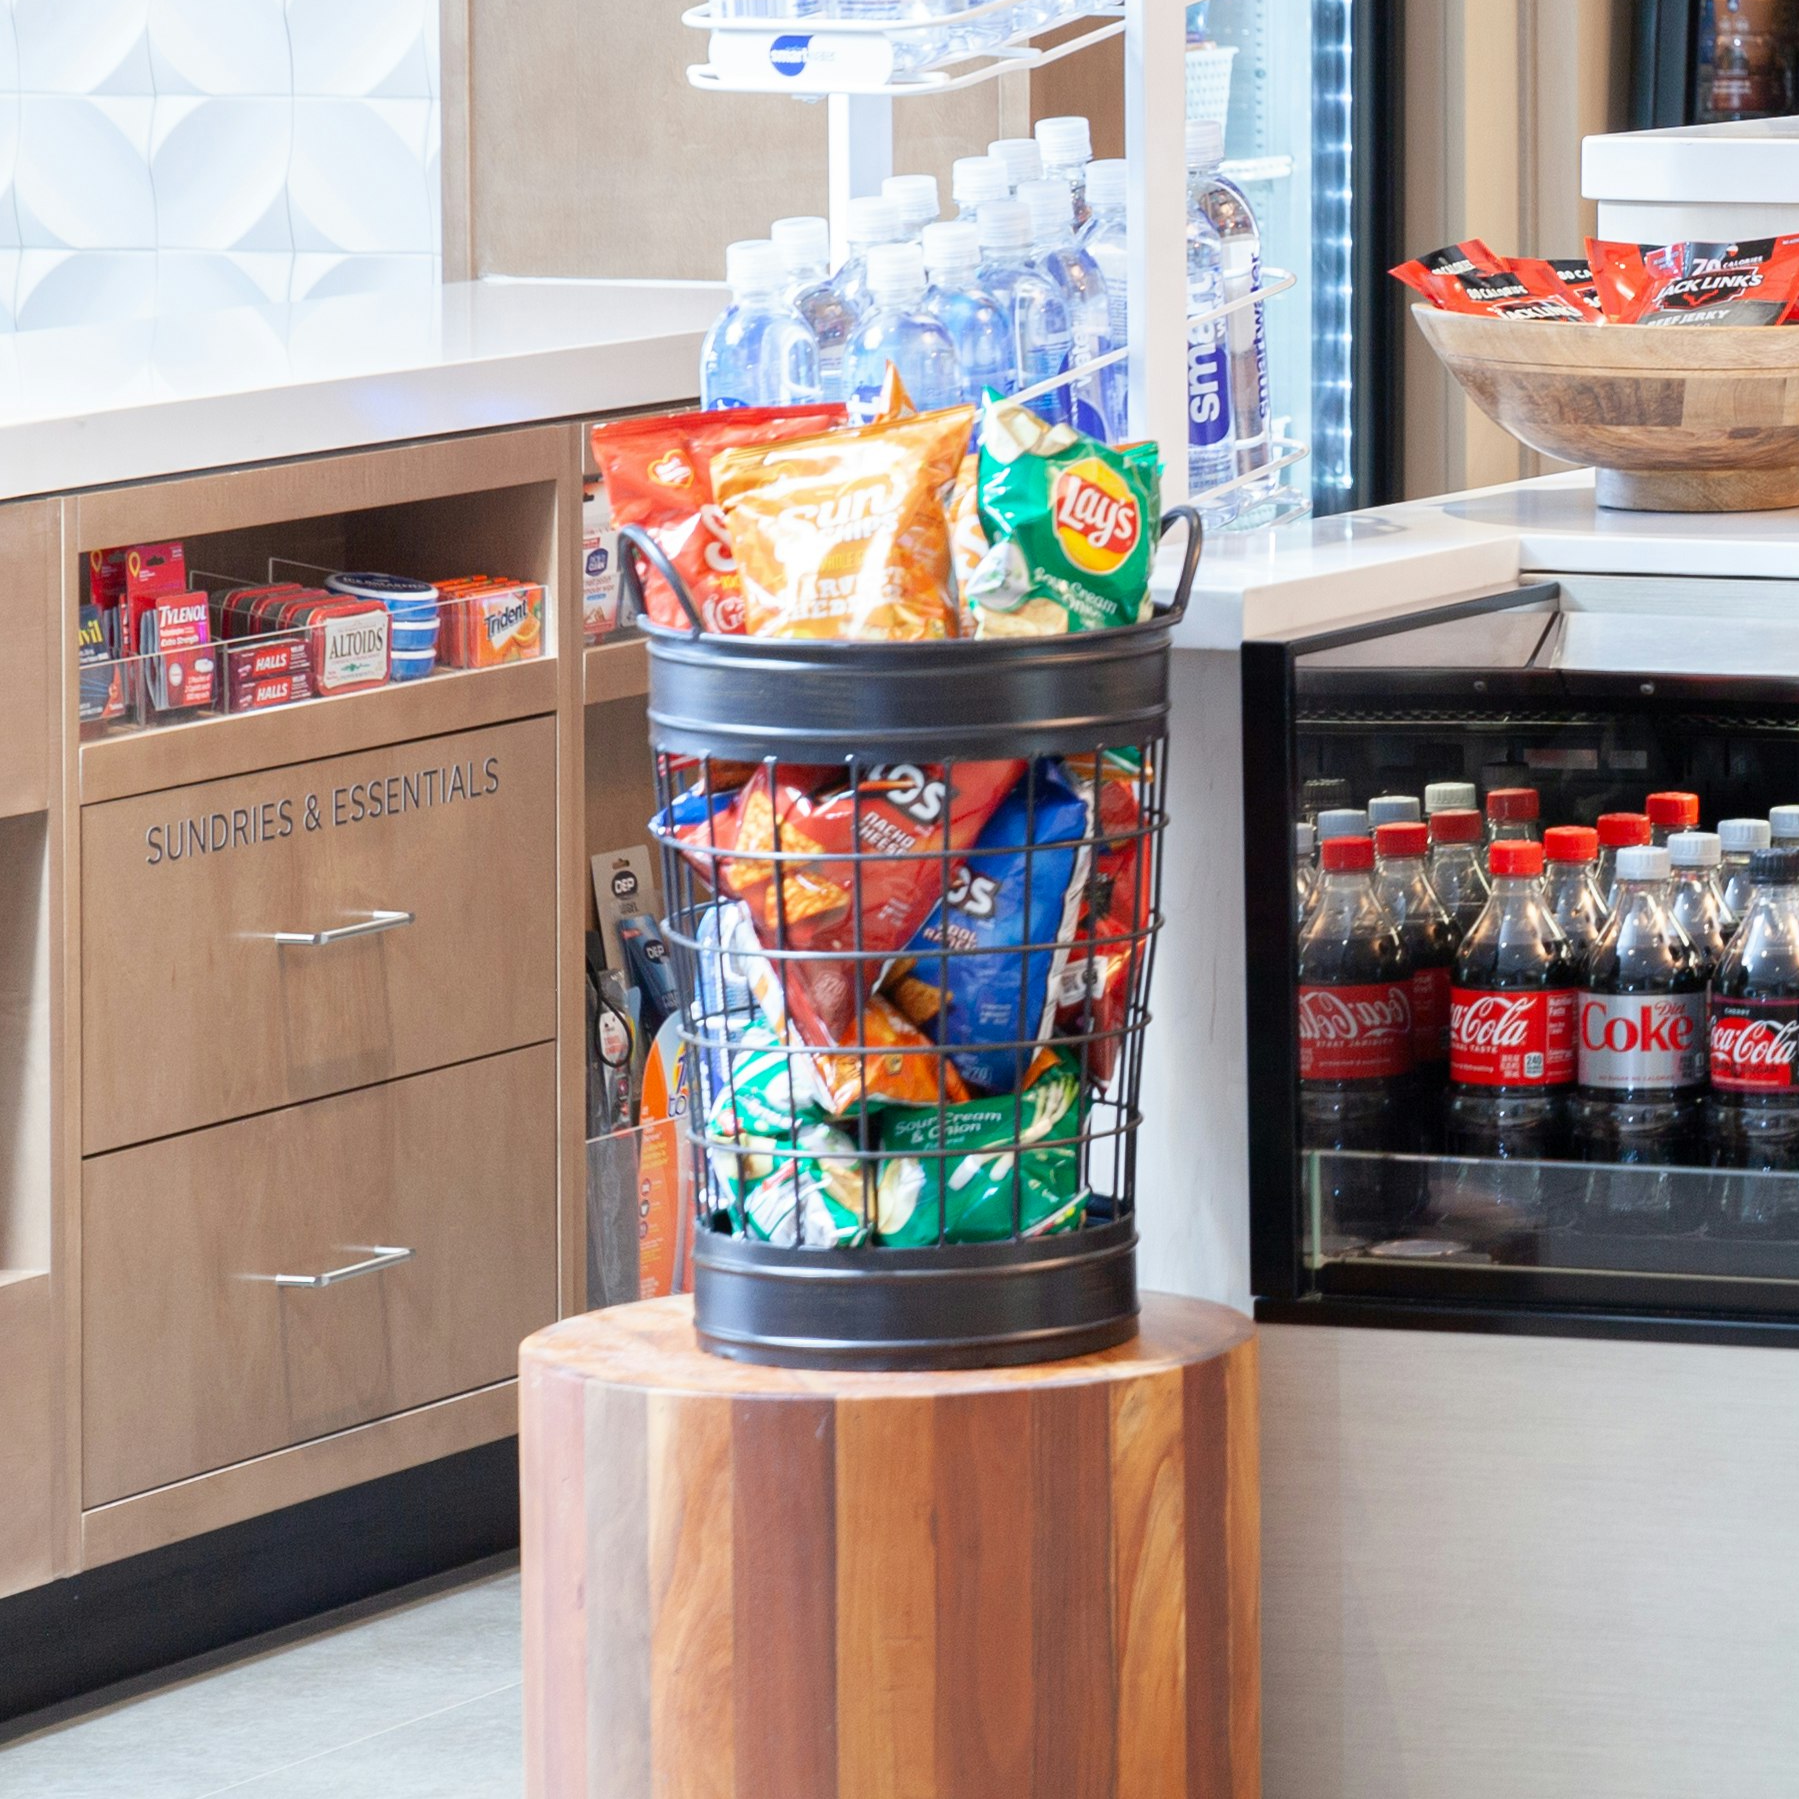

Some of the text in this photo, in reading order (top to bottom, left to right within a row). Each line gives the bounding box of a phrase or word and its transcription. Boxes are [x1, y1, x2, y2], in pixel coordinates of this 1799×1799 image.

[1691, 255, 1764, 276] 70 CALORIES
[1679, 308, 1730, 326] JERKY
[1056, 474, 1138, 549] Lay's
[1066, 581, 1118, 618] Cream
[158, 604, 207, 628] TYLENOL
[484, 598, 529, 637] Trident
[329, 626, 384, 660] ALTOIDS
[255, 653, 288, 672] HALLS
[256, 682, 289, 702] HALLS
[145, 756, 500, 865] SUNDRIES & ESSENTIALS
[613, 877, 635, 892] DEP
[646, 945, 667, 960] DEP
[1653, 1001, 1687, 1017] Diet
[1581, 1000, 1695, 1053] Coke
[1525, 1055, 1543, 1067] 240
[948, 1109, 1003, 1125] Cream
